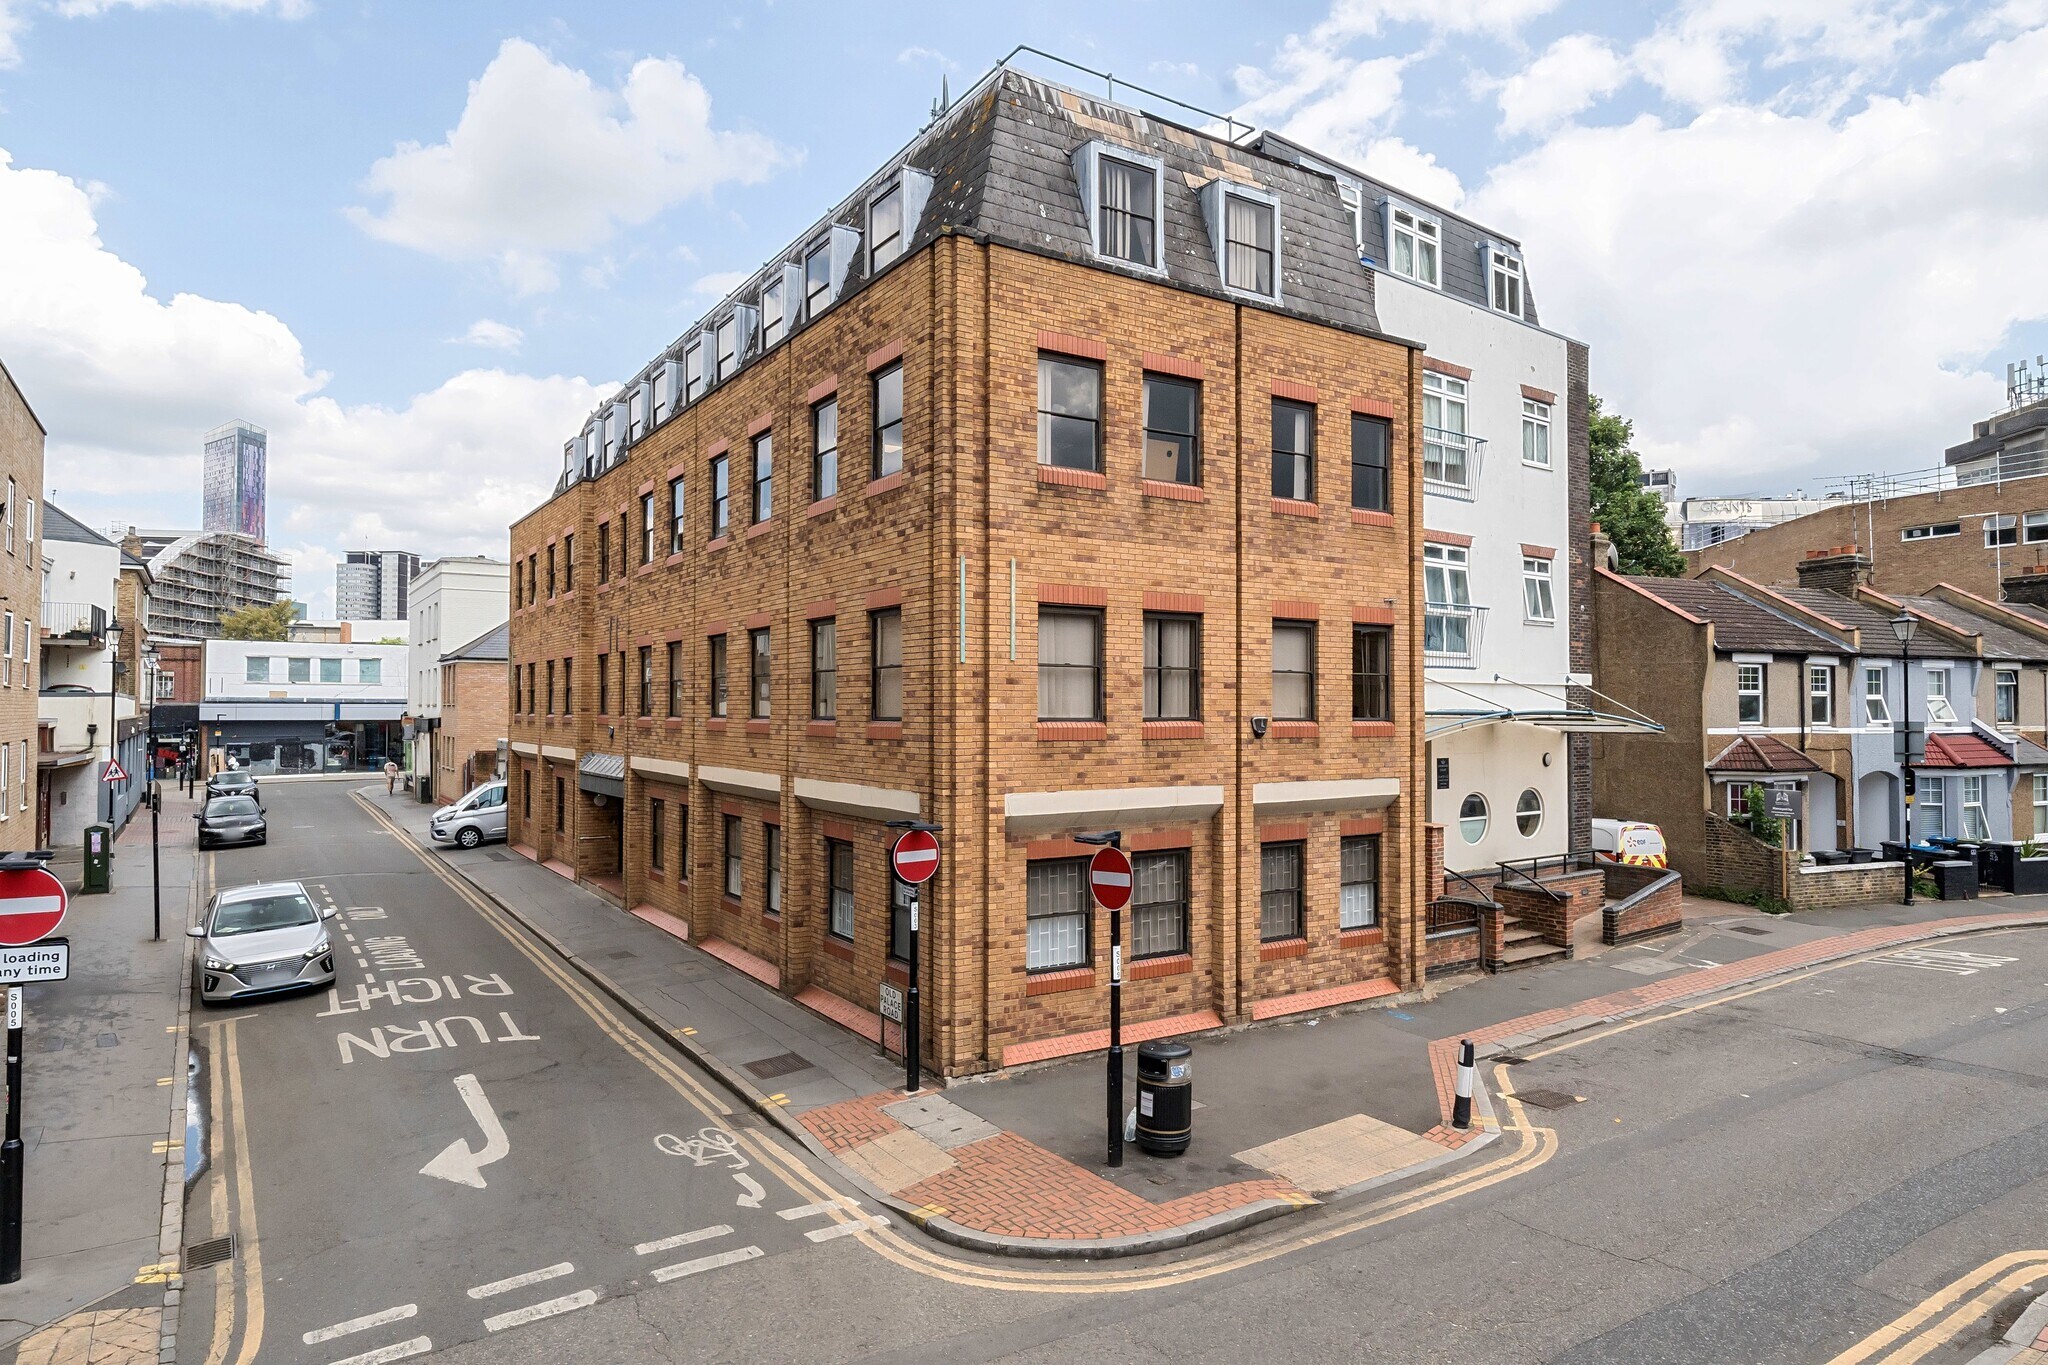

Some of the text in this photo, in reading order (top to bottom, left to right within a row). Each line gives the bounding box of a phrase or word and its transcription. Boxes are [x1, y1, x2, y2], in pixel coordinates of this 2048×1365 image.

[1701, 502, 1753, 513] GRANTS
[3, 952, 60, 964] loading
[364, 935, 426, 972] LOADING
[0, 965, 61, 979] ny time
[885, 987, 897, 999] OLD
[10, 993, 18, 1027] S005
[880, 994, 902, 1011] PALACE
[883, 1004, 899, 1019] ROAD
[337, 1011, 541, 1064] TURN
